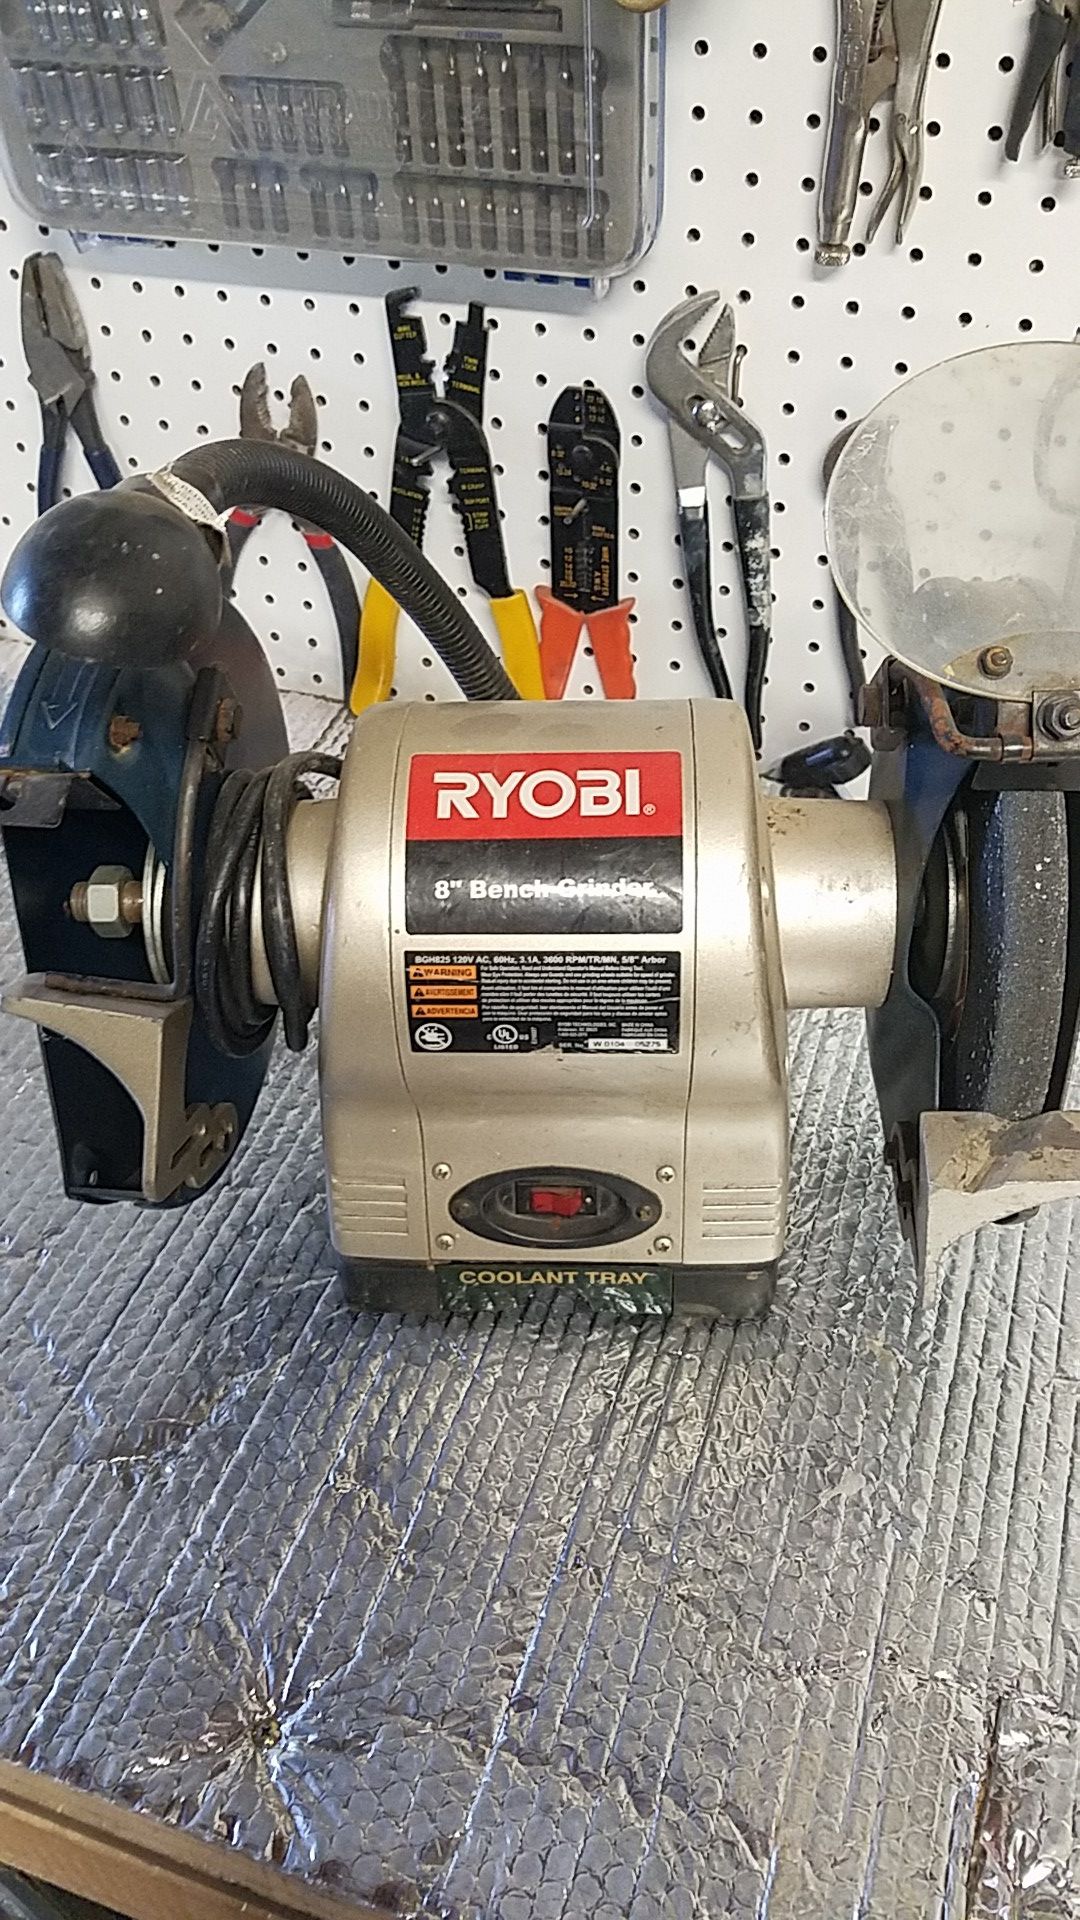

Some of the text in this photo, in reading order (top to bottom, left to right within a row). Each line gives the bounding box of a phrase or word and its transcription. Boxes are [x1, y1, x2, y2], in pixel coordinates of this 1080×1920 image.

[433, 769, 641, 819] RYOBI
[434, 877, 655, 899] 8" Bench Grinder
[476, 956, 492, 964] AC,
[424, 969, 472, 977] WARNING
[459, 1271, 648, 1285] COOLANT TRAY
